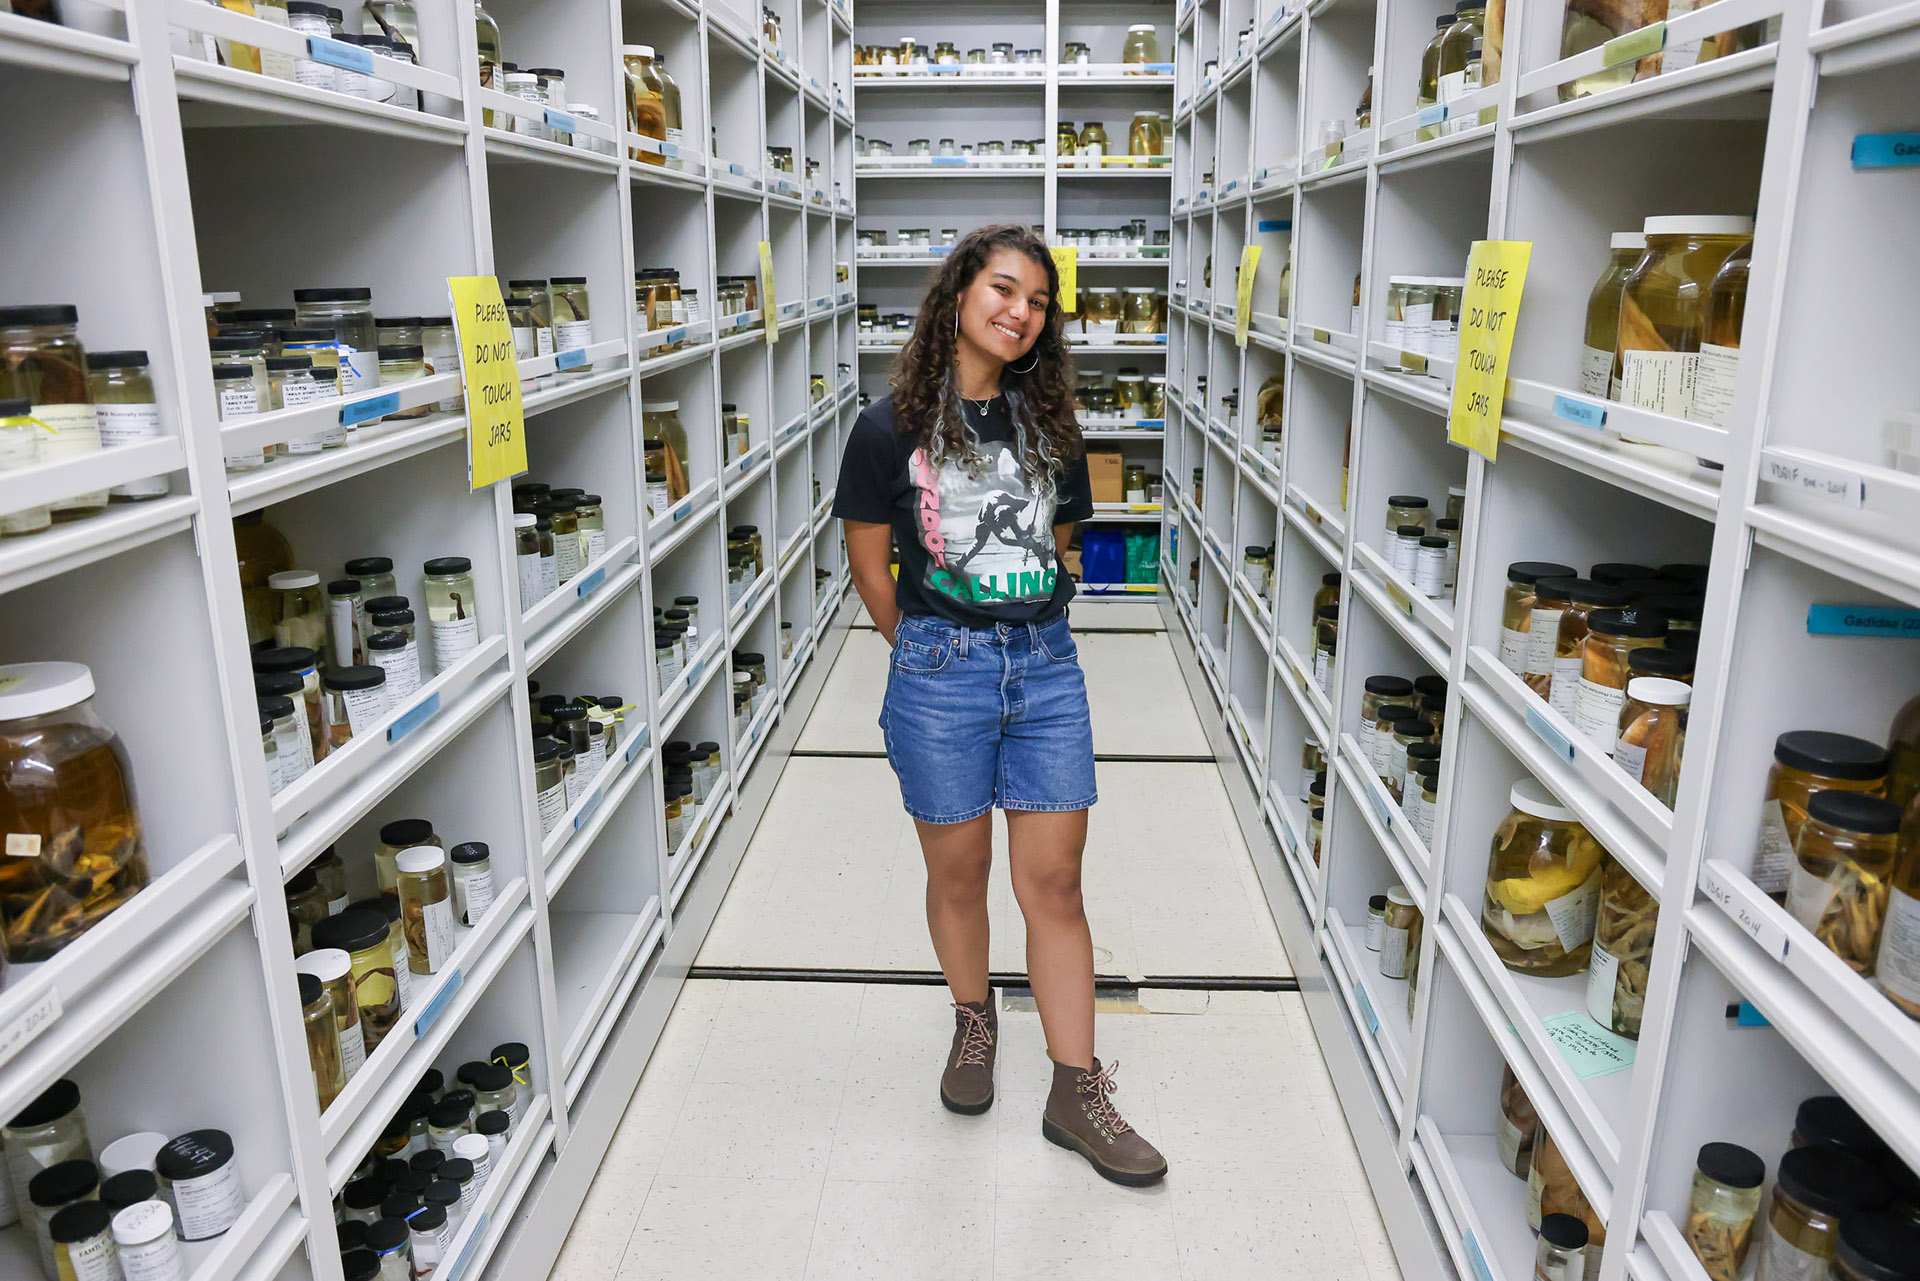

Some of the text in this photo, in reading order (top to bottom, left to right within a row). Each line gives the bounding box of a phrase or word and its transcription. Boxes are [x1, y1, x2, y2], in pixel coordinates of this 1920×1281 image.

[1476, 267, 1508, 289] PLEASE
[475, 302, 505, 323] PLEASE
[1469, 307, 1507, 332] DO NOT
[476, 340, 512, 364] DO NOT
[1470, 349, 1497, 376] TOUCH
[482, 381, 512, 405] TOUCH
[1467, 391, 1490, 417] JARS
[488, 420, 512, 447] JARS
[930, 567, 1057, 603] CALLING
